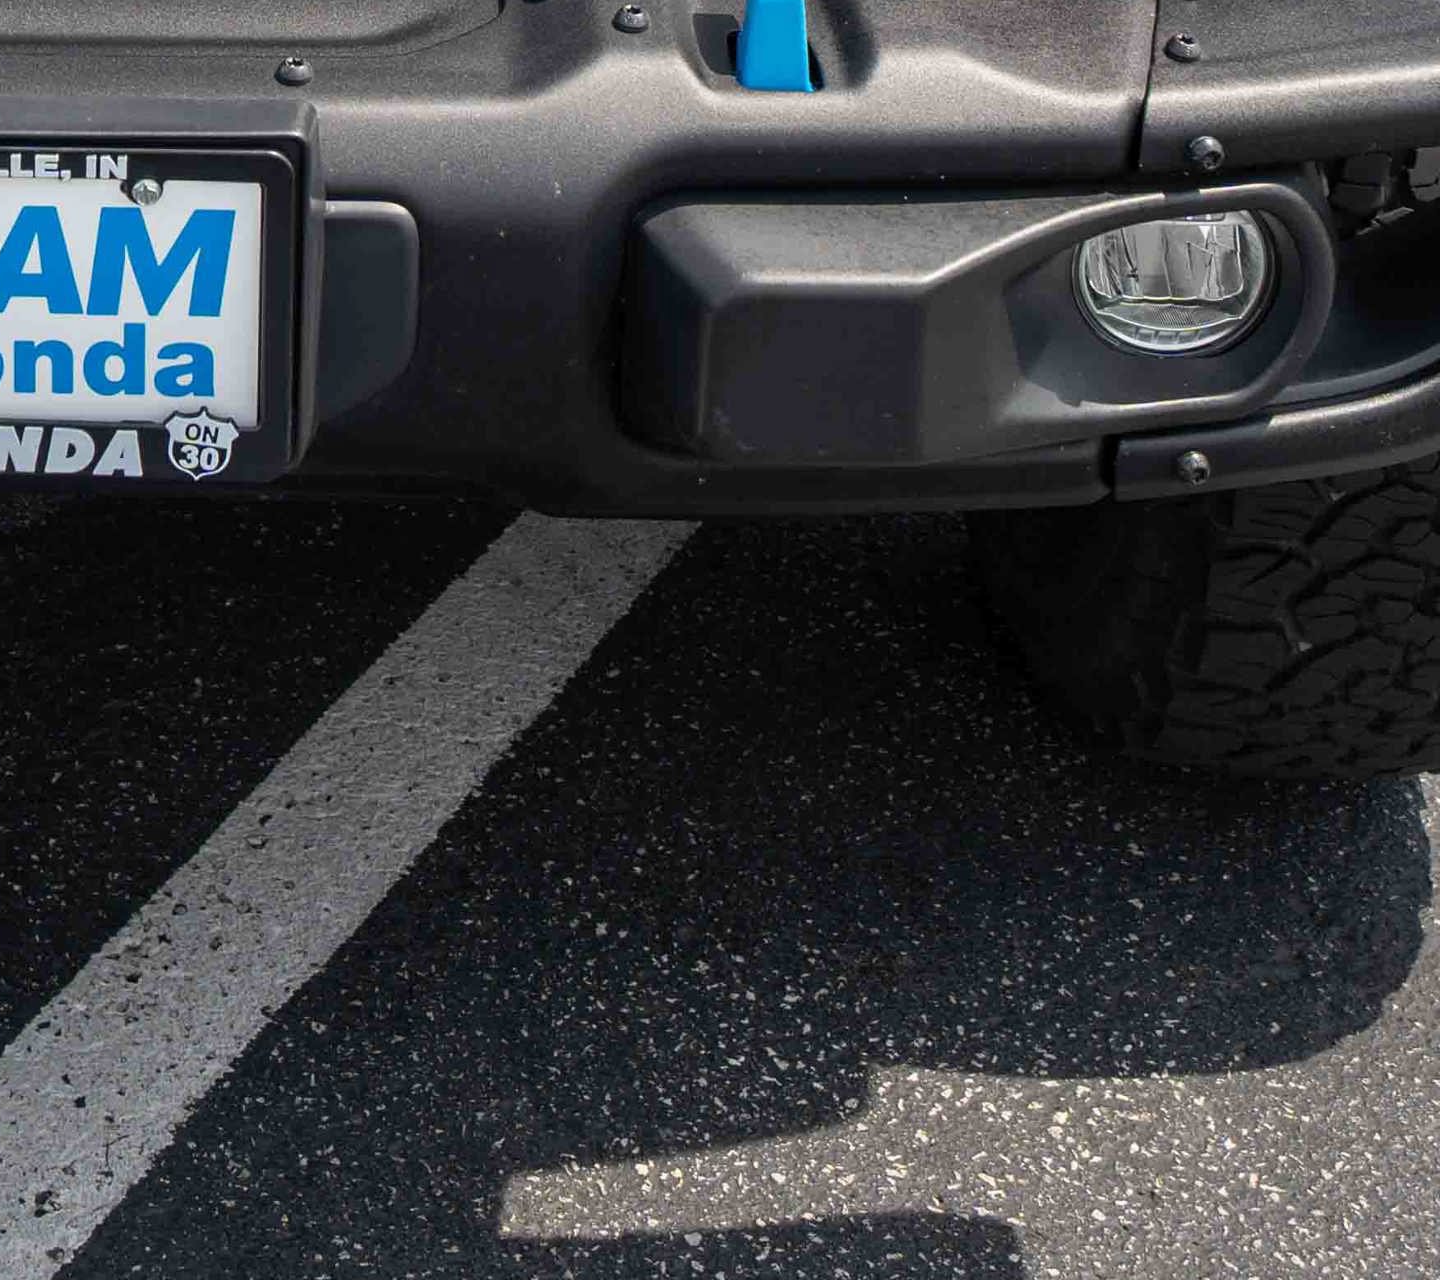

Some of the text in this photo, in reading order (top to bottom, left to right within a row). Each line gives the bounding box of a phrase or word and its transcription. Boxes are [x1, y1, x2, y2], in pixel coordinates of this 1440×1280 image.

[85, 154, 129, 180] IN
[185, 423, 219, 444] ON
[178, 444, 220, 472] 30
